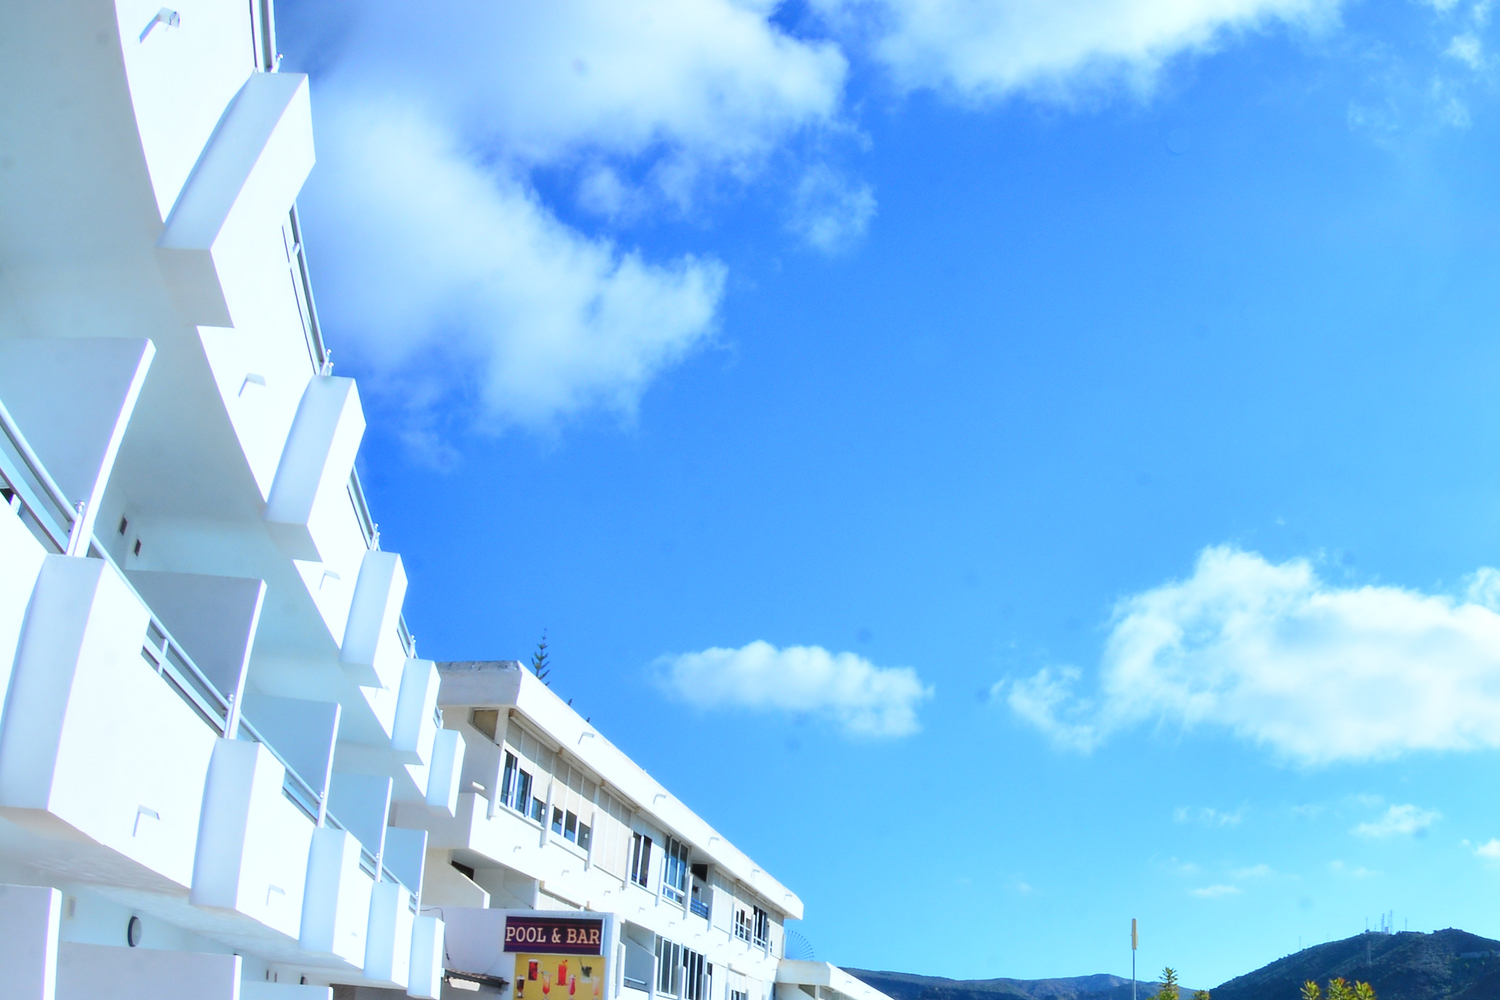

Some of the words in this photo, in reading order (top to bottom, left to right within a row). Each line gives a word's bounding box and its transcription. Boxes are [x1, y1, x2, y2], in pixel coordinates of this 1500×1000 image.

[505, 926, 546, 942] POOL
[551, 928, 561, 943] &
[566, 928, 600, 944] BAR
